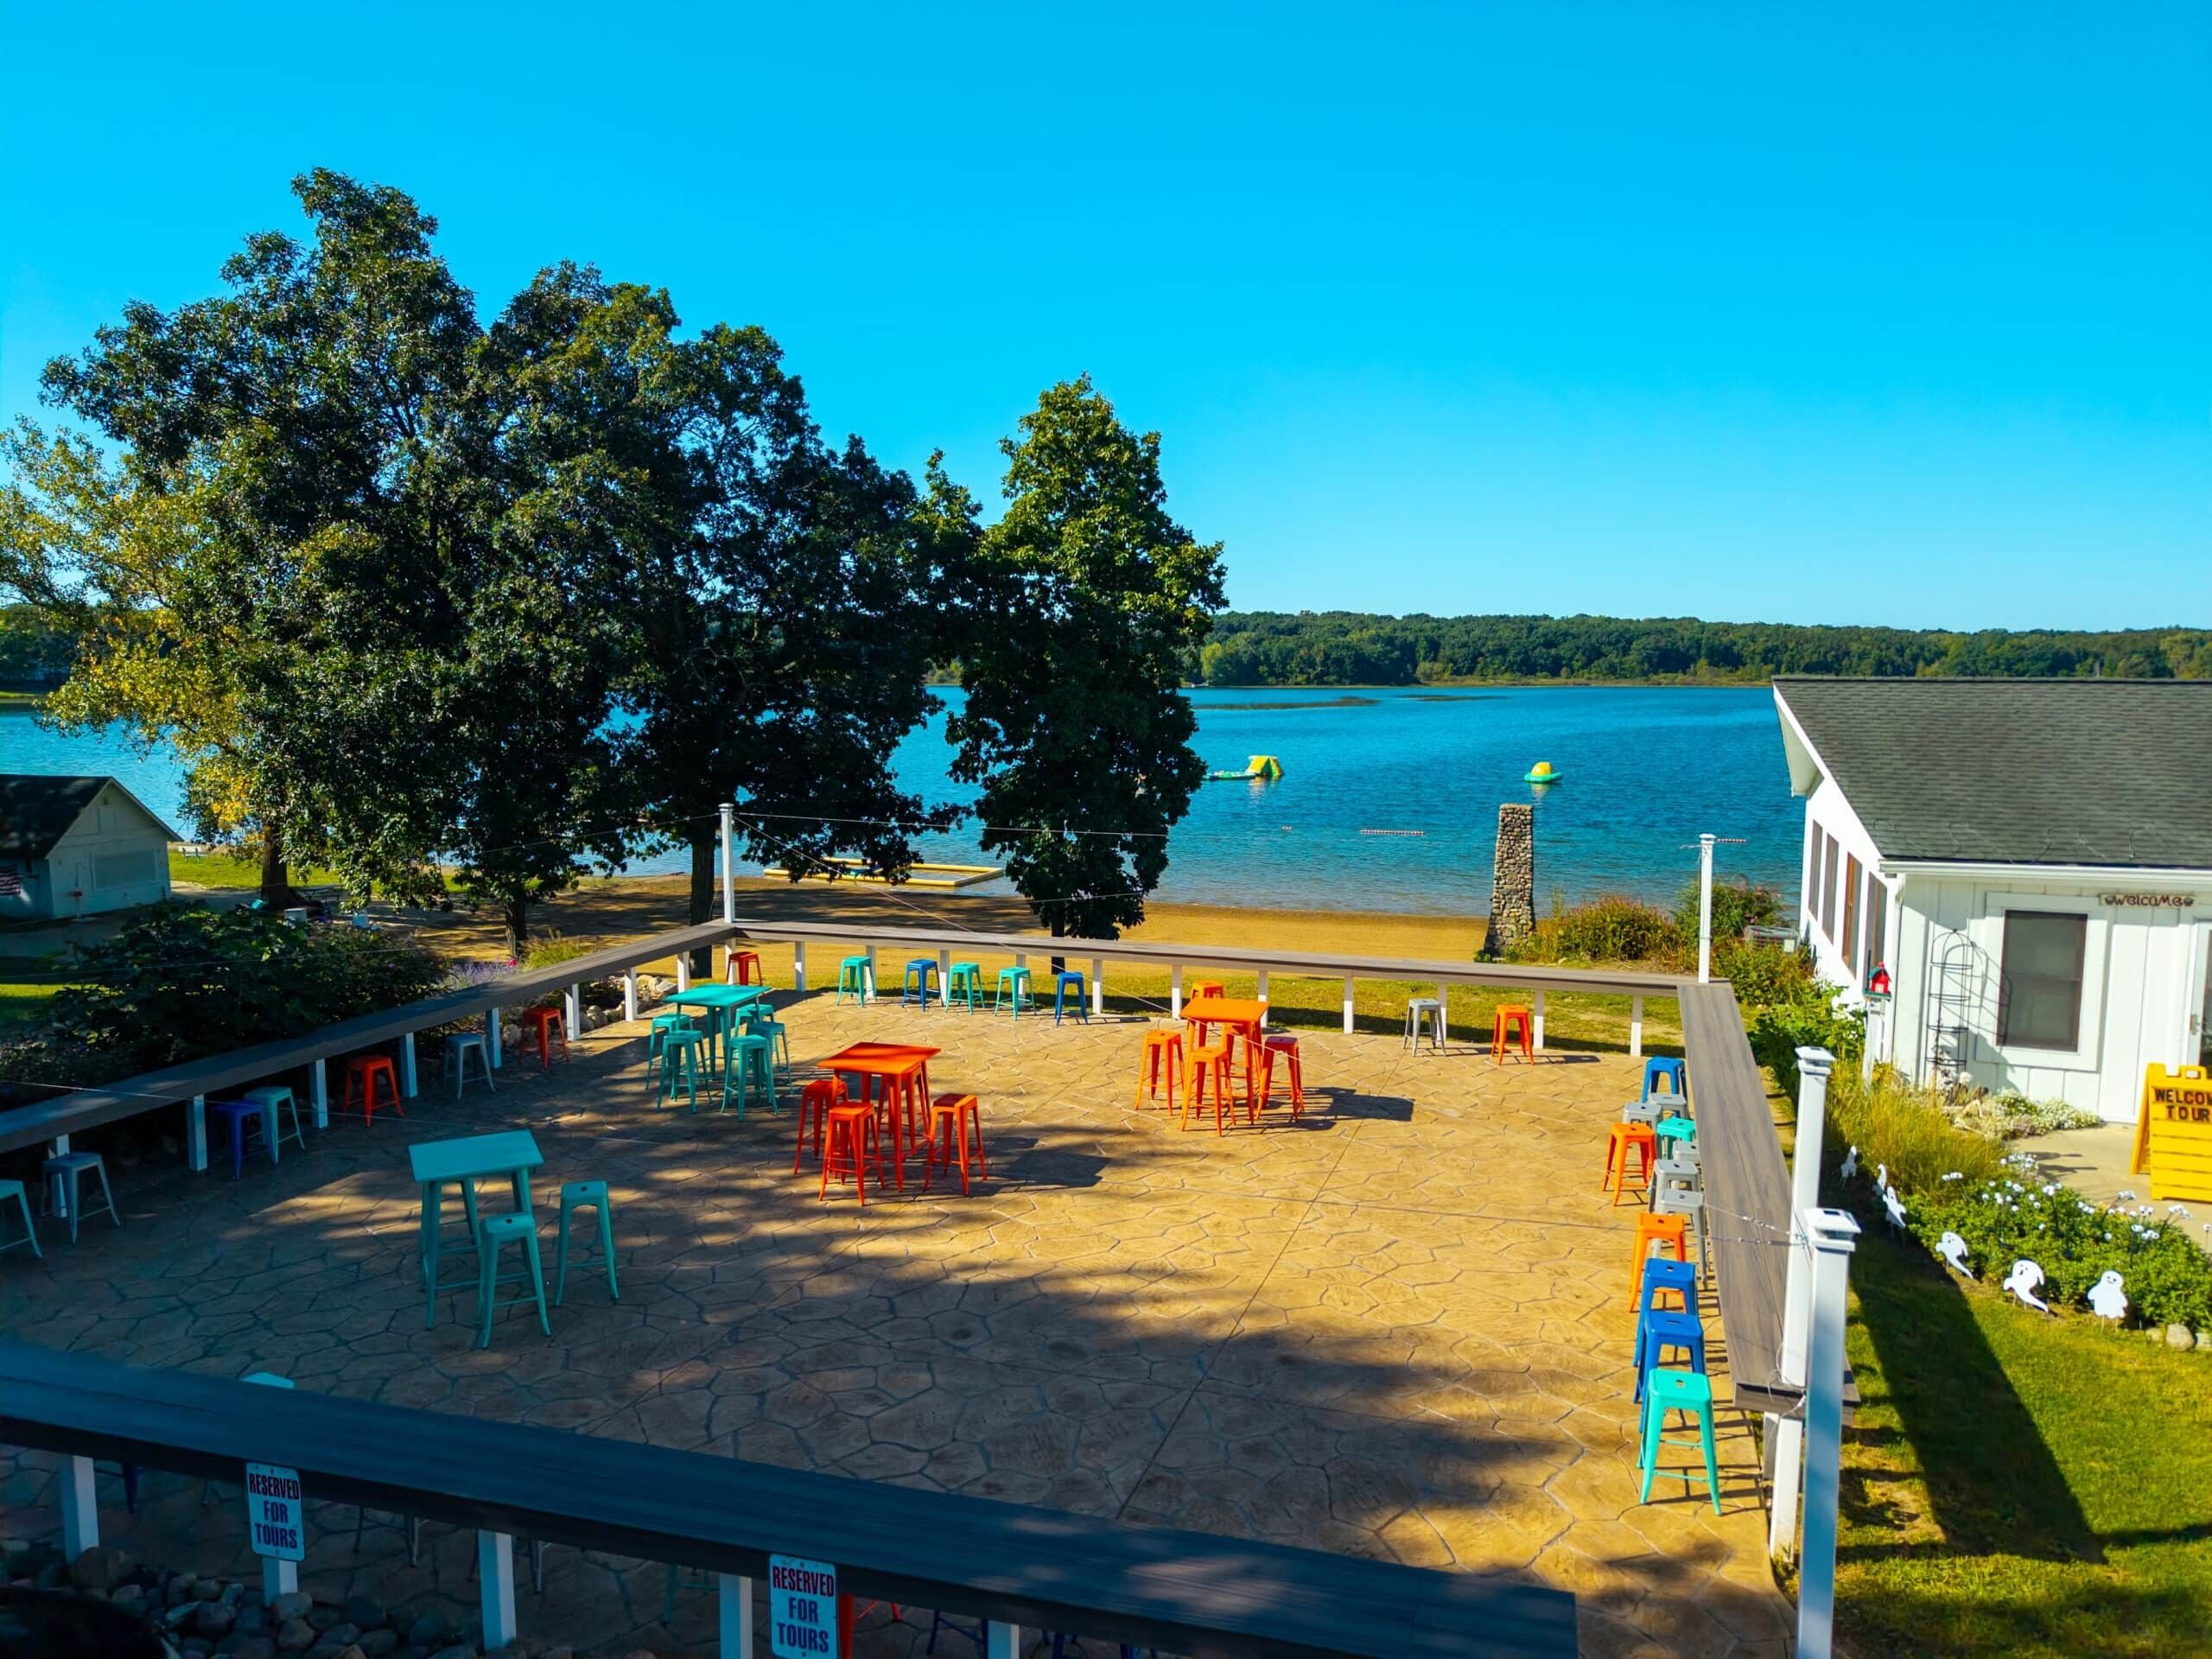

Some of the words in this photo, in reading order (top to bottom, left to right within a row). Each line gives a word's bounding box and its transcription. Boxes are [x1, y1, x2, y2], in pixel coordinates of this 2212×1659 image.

[249, 1473, 300, 1500] RESERVED
[264, 1500, 289, 1523] FOR
[255, 1522, 297, 1549] TOURS
[772, 1566, 834, 1598] RESERVED
[788, 1597, 818, 1624] FOR
[777, 1623, 829, 1653] TOURS
